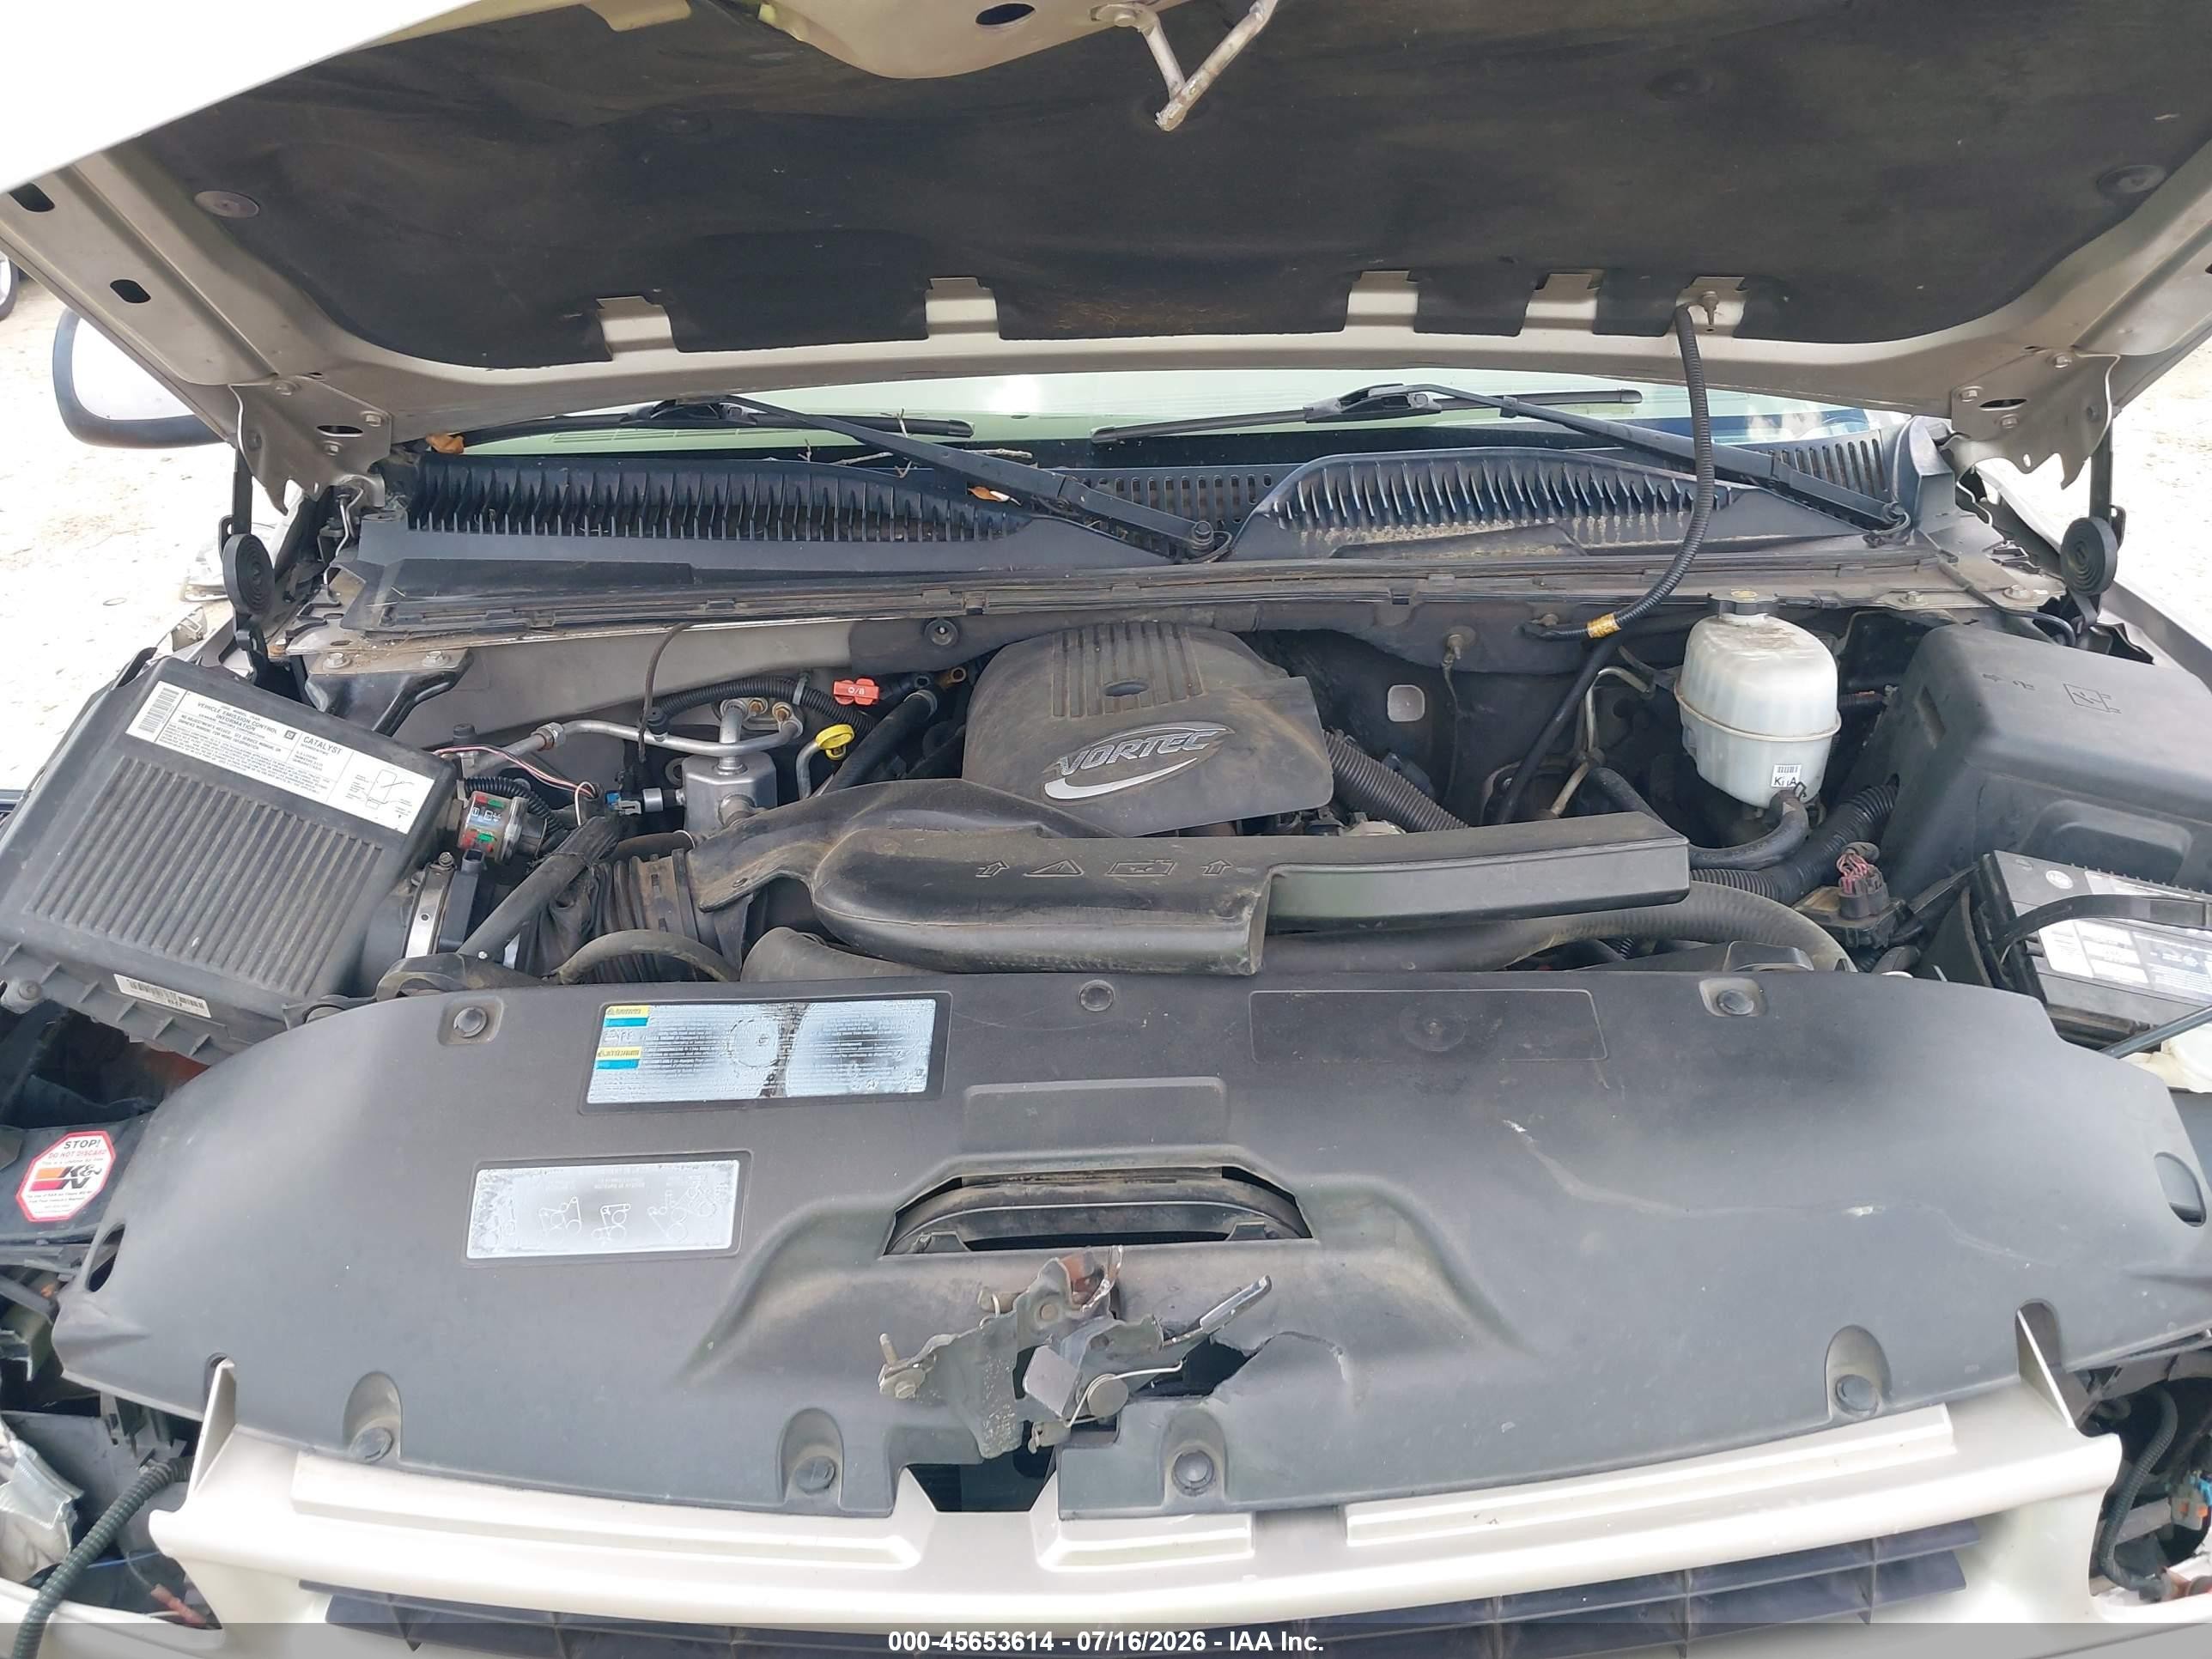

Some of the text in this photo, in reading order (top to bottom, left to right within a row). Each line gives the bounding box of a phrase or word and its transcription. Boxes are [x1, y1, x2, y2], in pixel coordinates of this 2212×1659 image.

[198, 702, 222, 714] VEHICLE
[222, 709, 251, 724] EMISSION
[252, 720, 277, 734] CONTROL
[216, 714, 257, 731] INFORMATION
[303, 736, 343, 755] CATALYST
[1059, 731, 1218, 775] VORTEC
[64, 1139, 101, 1149] STOP!
[58, 1164, 103, 1189] K&N
